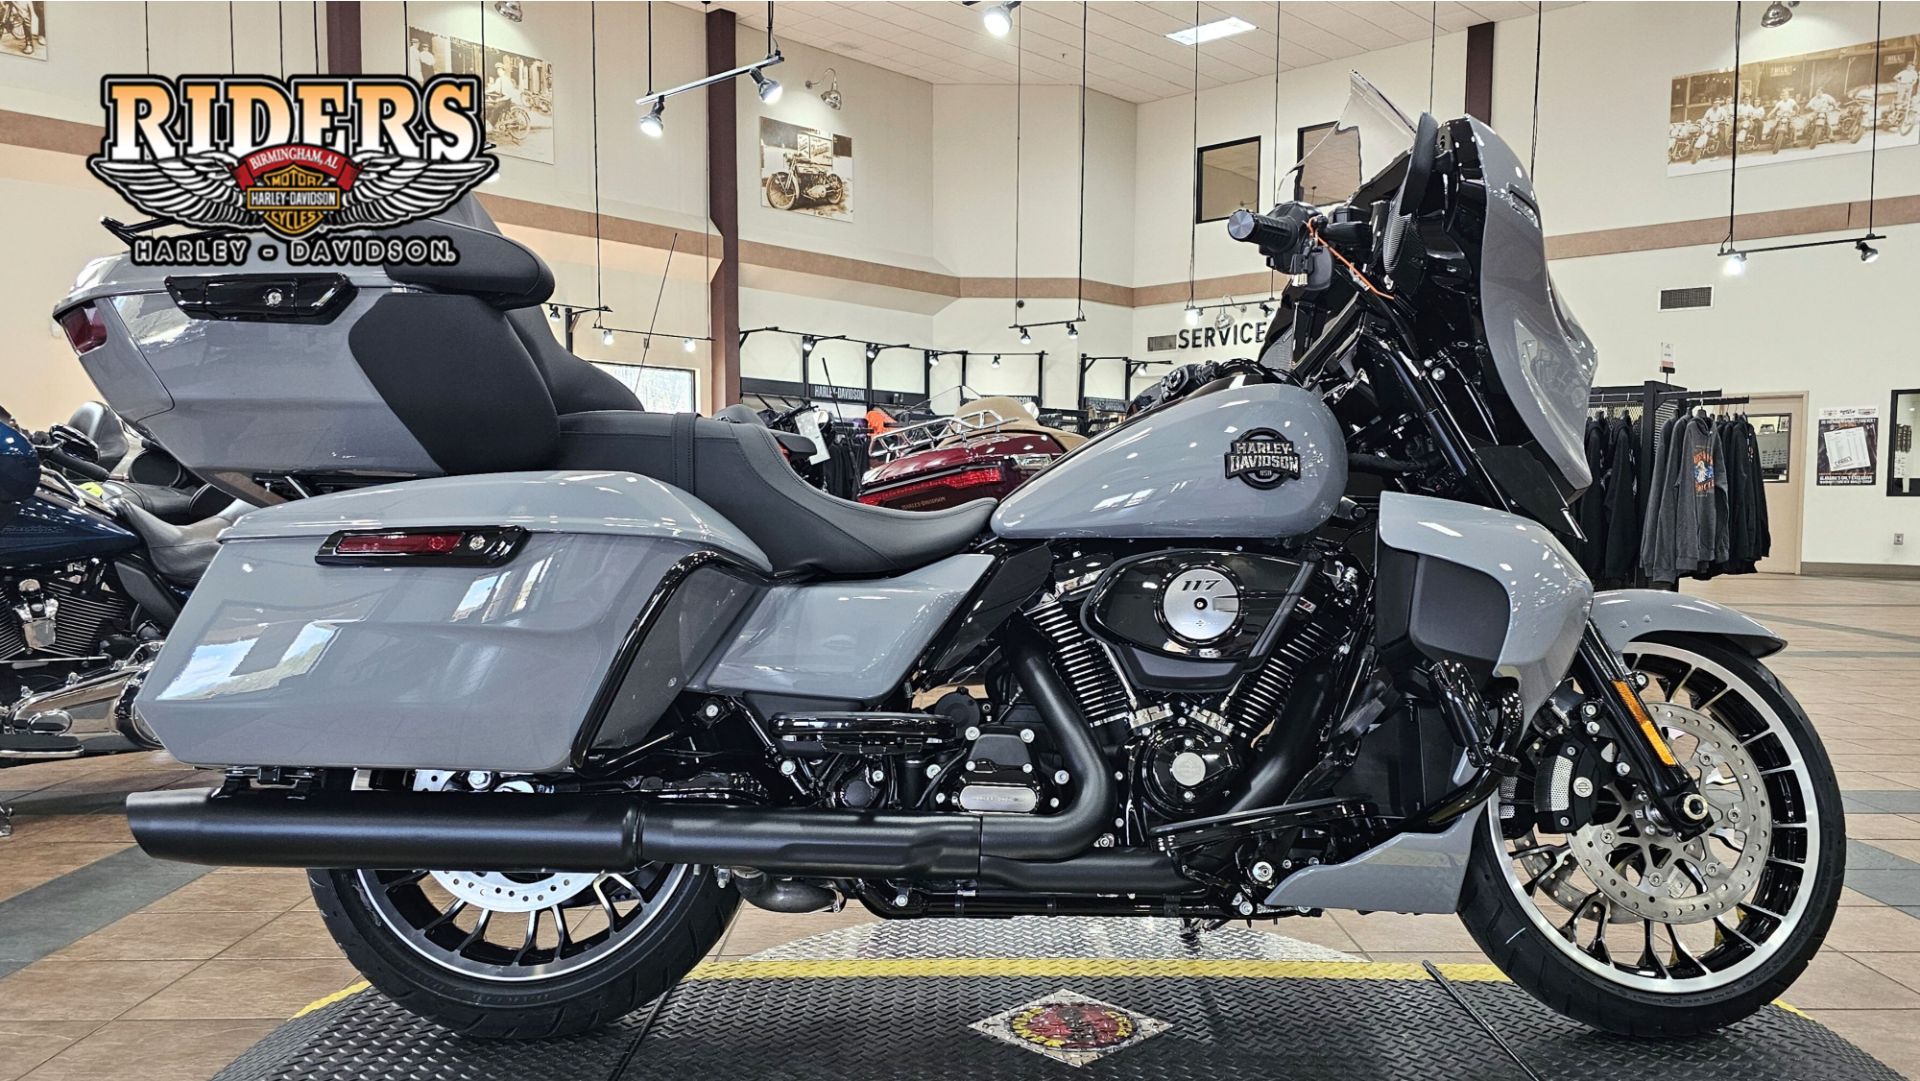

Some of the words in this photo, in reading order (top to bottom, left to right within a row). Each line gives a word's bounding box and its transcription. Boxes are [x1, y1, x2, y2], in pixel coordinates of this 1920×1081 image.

[1178, 321, 1267, 349] SERVICE
[814, 385, 865, 400] HARLEY-DAVIDSON
[1230, 455, 1299, 473] DAVIDSON
[1182, 580, 1221, 591] 117
